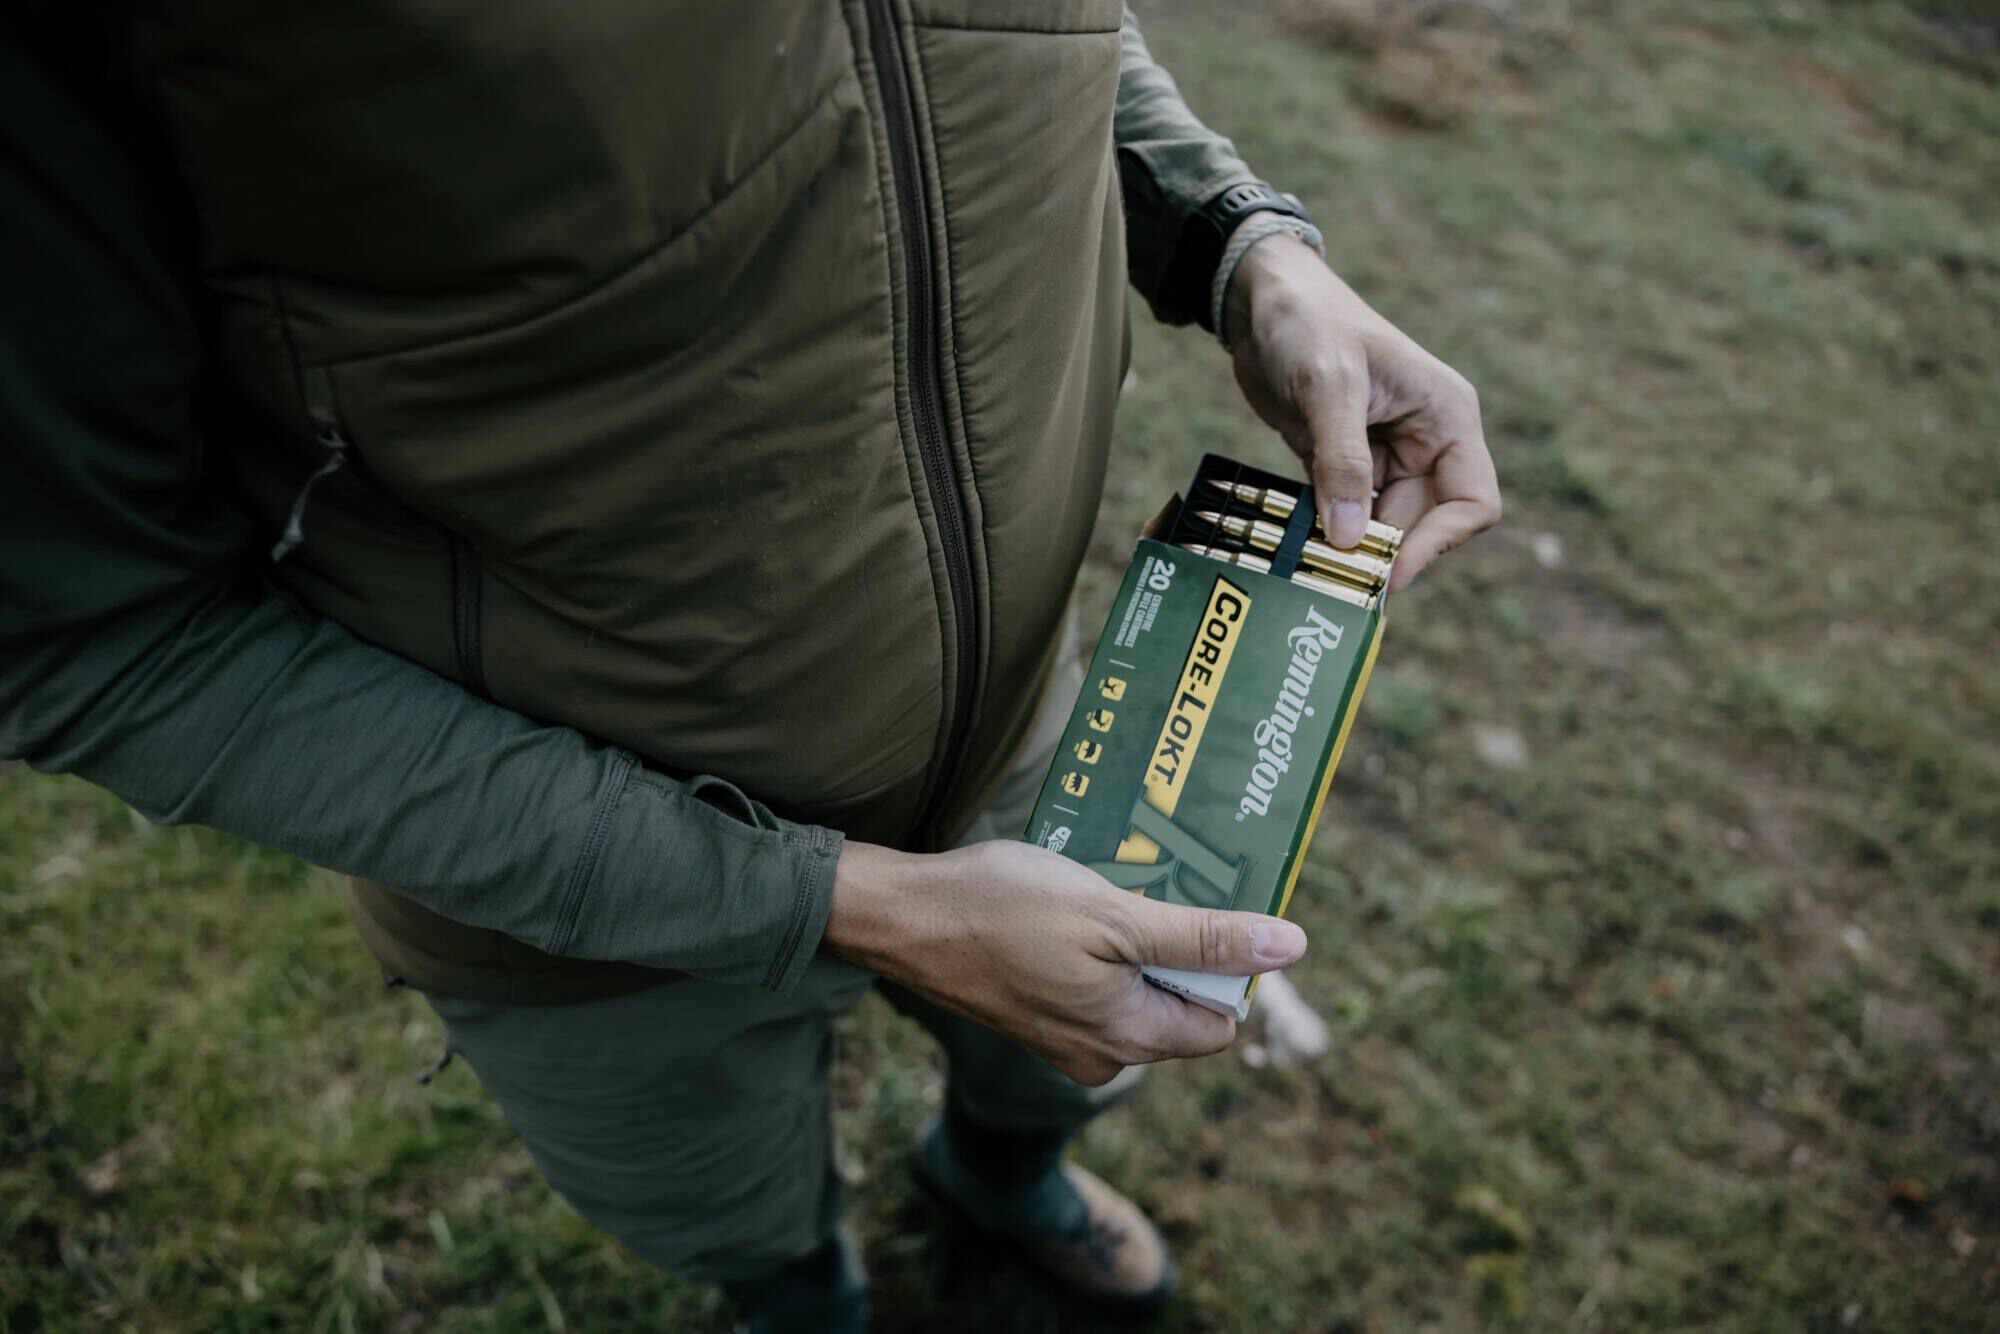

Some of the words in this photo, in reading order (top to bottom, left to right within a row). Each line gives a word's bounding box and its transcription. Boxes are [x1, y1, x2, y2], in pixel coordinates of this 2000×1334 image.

[1148, 559, 1176, 591] 20
[1154, 591, 1243, 786] CORE-LOKT
[1240, 604, 1345, 817] Remington
